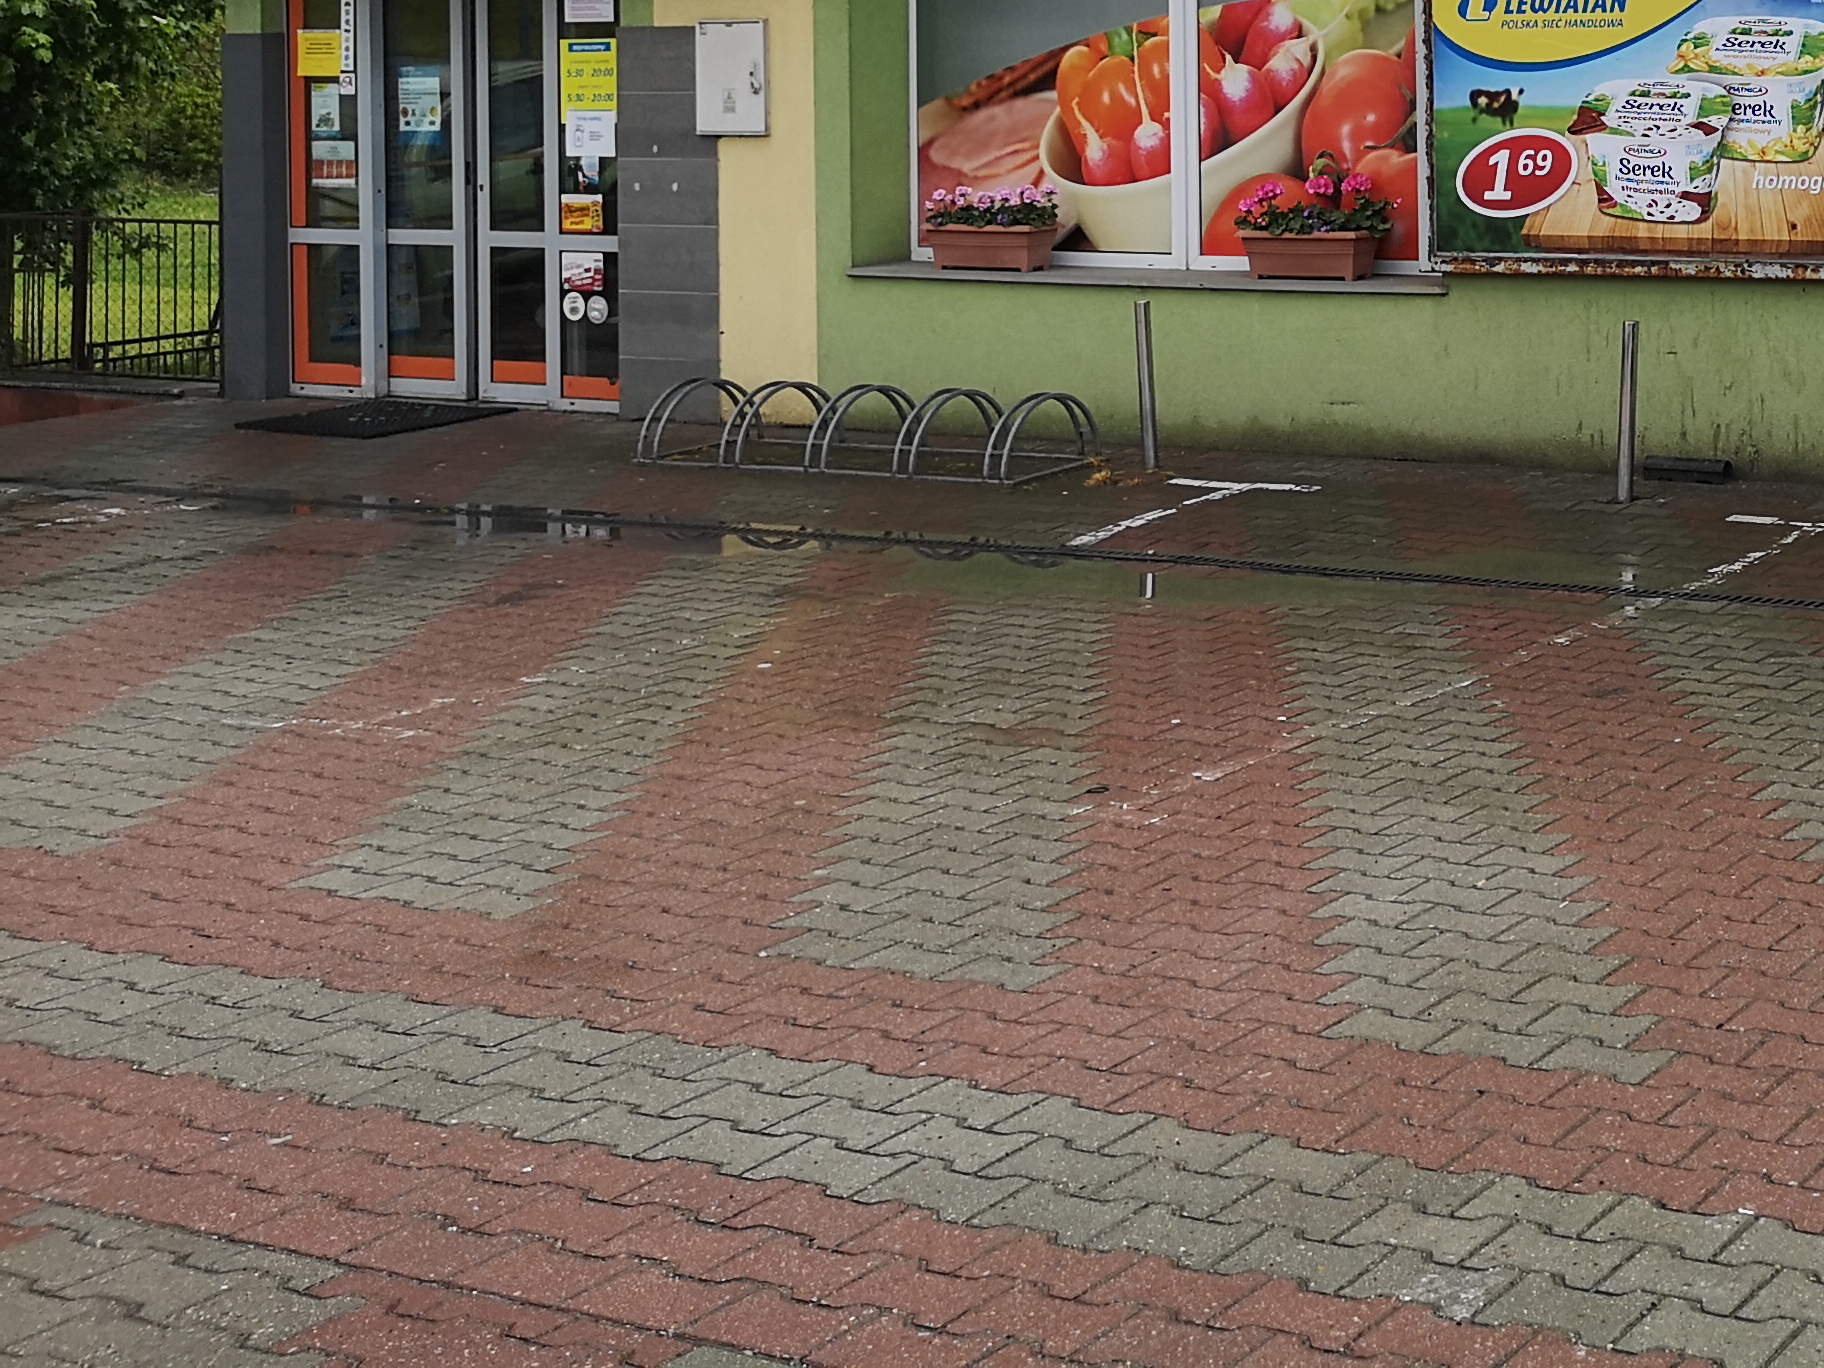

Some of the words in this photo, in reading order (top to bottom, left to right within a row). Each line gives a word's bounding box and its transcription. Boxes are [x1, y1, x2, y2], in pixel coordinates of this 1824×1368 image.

[1501, 19, 1539, 30] POLSKA
[1541, 17, 1563, 29] SIEĆ
[1564, 18, 1624, 29] HANDLOWA
[1721, 37, 1786, 50] Serek
[1621, 99, 1684, 113] Serek
[1731, 99, 1776, 119] erek
[1619, 158, 1675, 180] Serek
